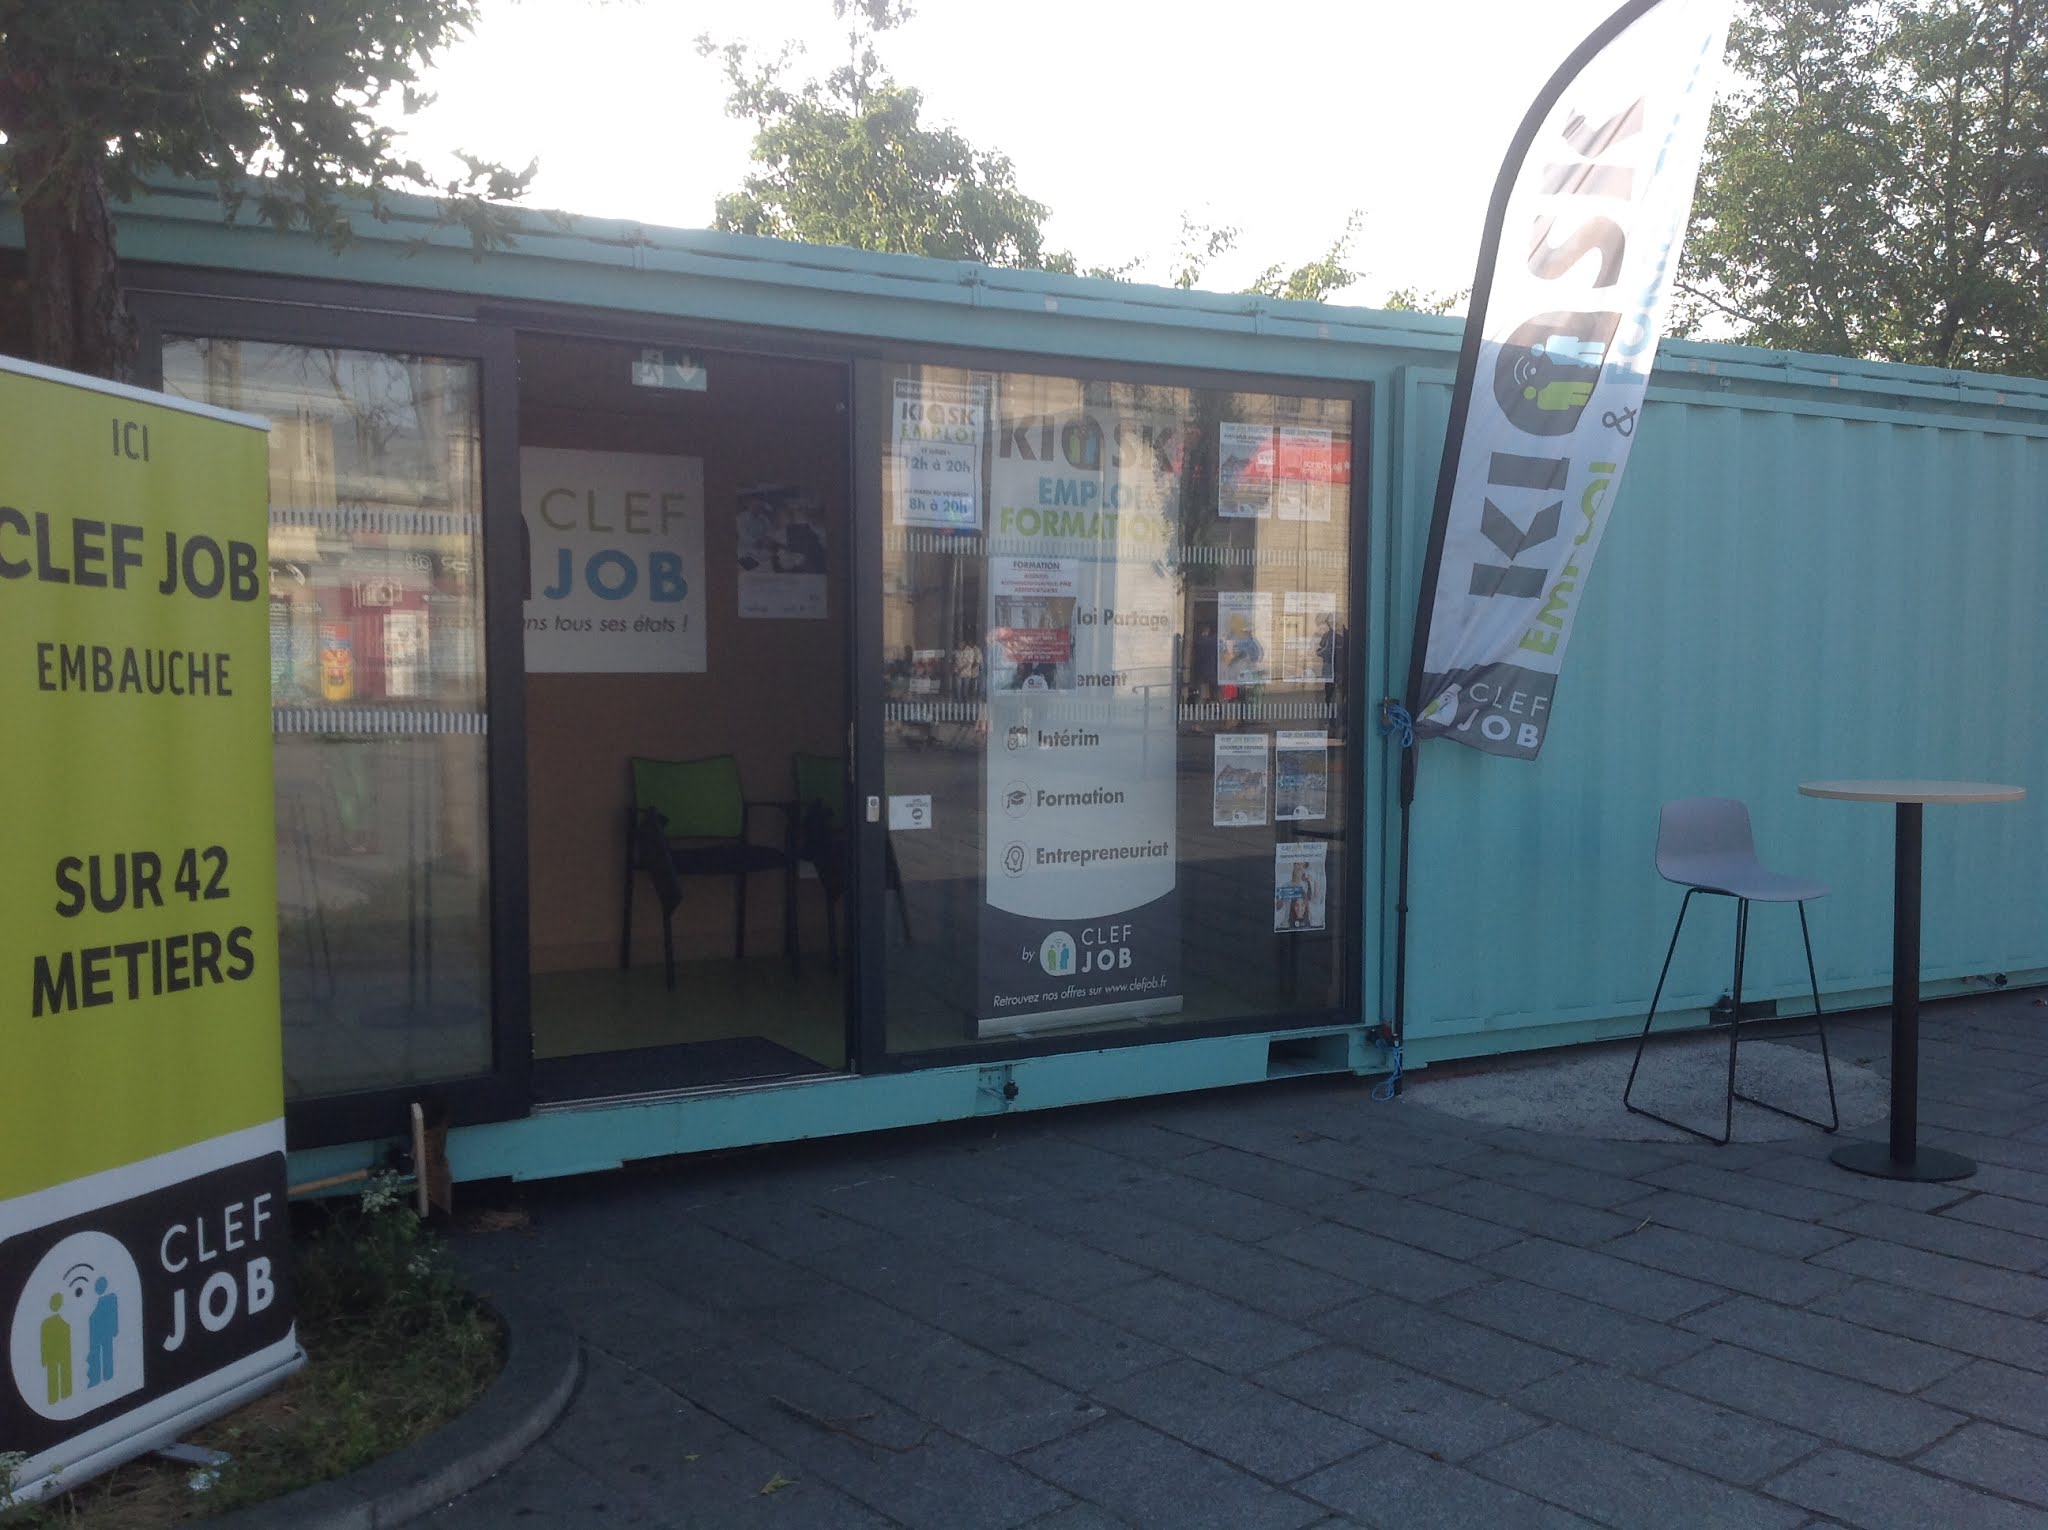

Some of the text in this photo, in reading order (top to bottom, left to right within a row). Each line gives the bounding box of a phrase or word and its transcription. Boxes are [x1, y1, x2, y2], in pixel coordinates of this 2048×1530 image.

[1469, 96, 1645, 599] KIOSK
[112, 418, 150, 462] ICI
[1602, 406, 1637, 438] &
[1000, 415, 1175, 473] KIOSK
[946, 460, 970, 473] 20h
[539, 487, 689, 536] CLEF
[943, 499, 967, 513] 20h
[0, 507, 260, 602] CLEF JOB
[1013, 560, 1060, 570] FORMATION
[543, 547, 689, 604] JOB
[554, 615, 593, 632] tous
[600, 618, 627, 633] ses
[633, 614, 675, 633] états
[37, 642, 233, 697] EMBAUCHE
[1469, 682, 1549, 718] CLEF
[1038, 729, 1100, 748] Intérim
[1457, 709, 1539, 749] JOB
[1036, 787, 1124, 807] Formation
[1036, 841, 1169, 866] Entrepreneuriat
[55, 845, 230, 918] SUR 42
[1081, 924, 1132, 946] CLEF
[32, 926, 255, 1018] METIERS
[1022, 946, 1035, 963] by
[1081, 947, 1132, 973] JOB
[993, 994, 1039, 1008] Retrouvez
[1042, 992, 1058, 1001] nos
[1061, 985, 1086, 999] offres
[1089, 987, 1102, 996] sur
[160, 1192, 272, 1273] CLEF
[163, 1256, 275, 1352] JOB
